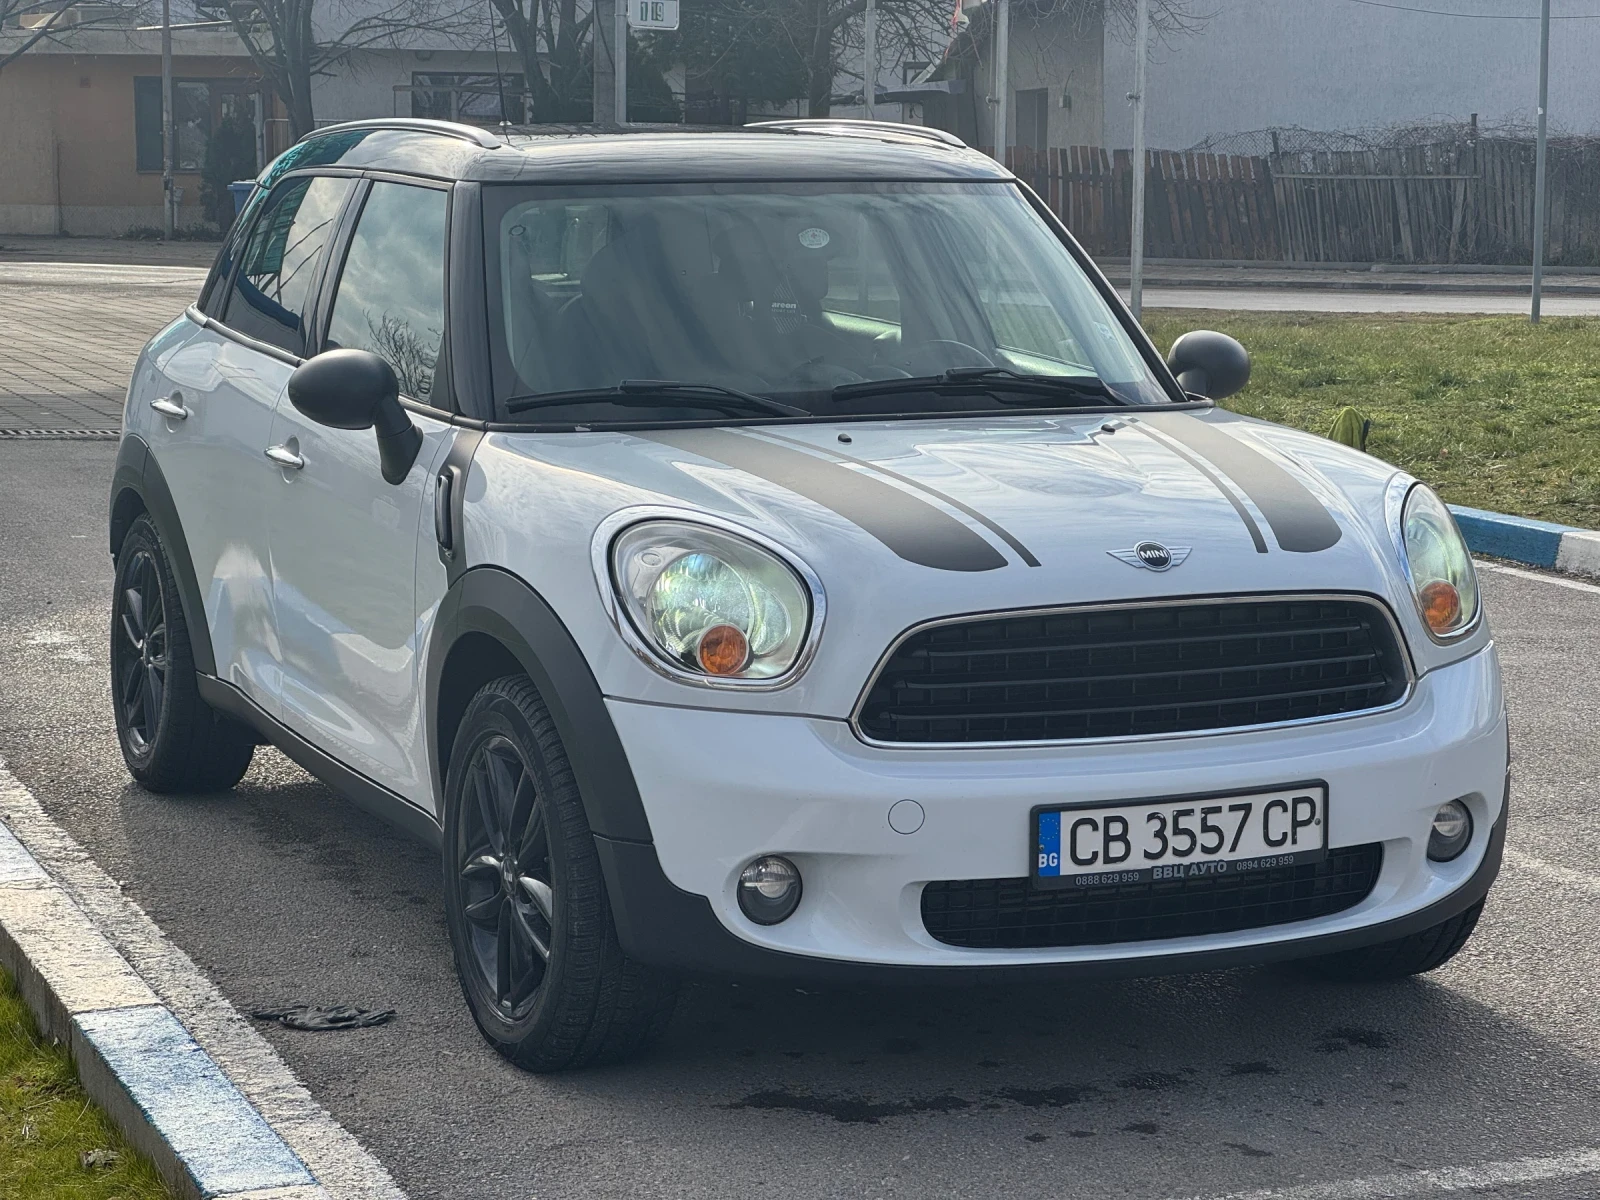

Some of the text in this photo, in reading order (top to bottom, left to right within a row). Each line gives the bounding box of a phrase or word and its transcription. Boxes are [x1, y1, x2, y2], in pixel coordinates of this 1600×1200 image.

[651, 2, 664, 21] 19
[1140, 549, 1168, 559] MINI
[1069, 795, 1317, 866] CB 3557 CP
[1038, 852, 1059, 868] BG
[1236, 854, 1294, 871] 0894 629 959
[1152, 861, 1227, 879] ВВЦ АУТО
[1075, 872, 1140, 886] 0888 629 959
